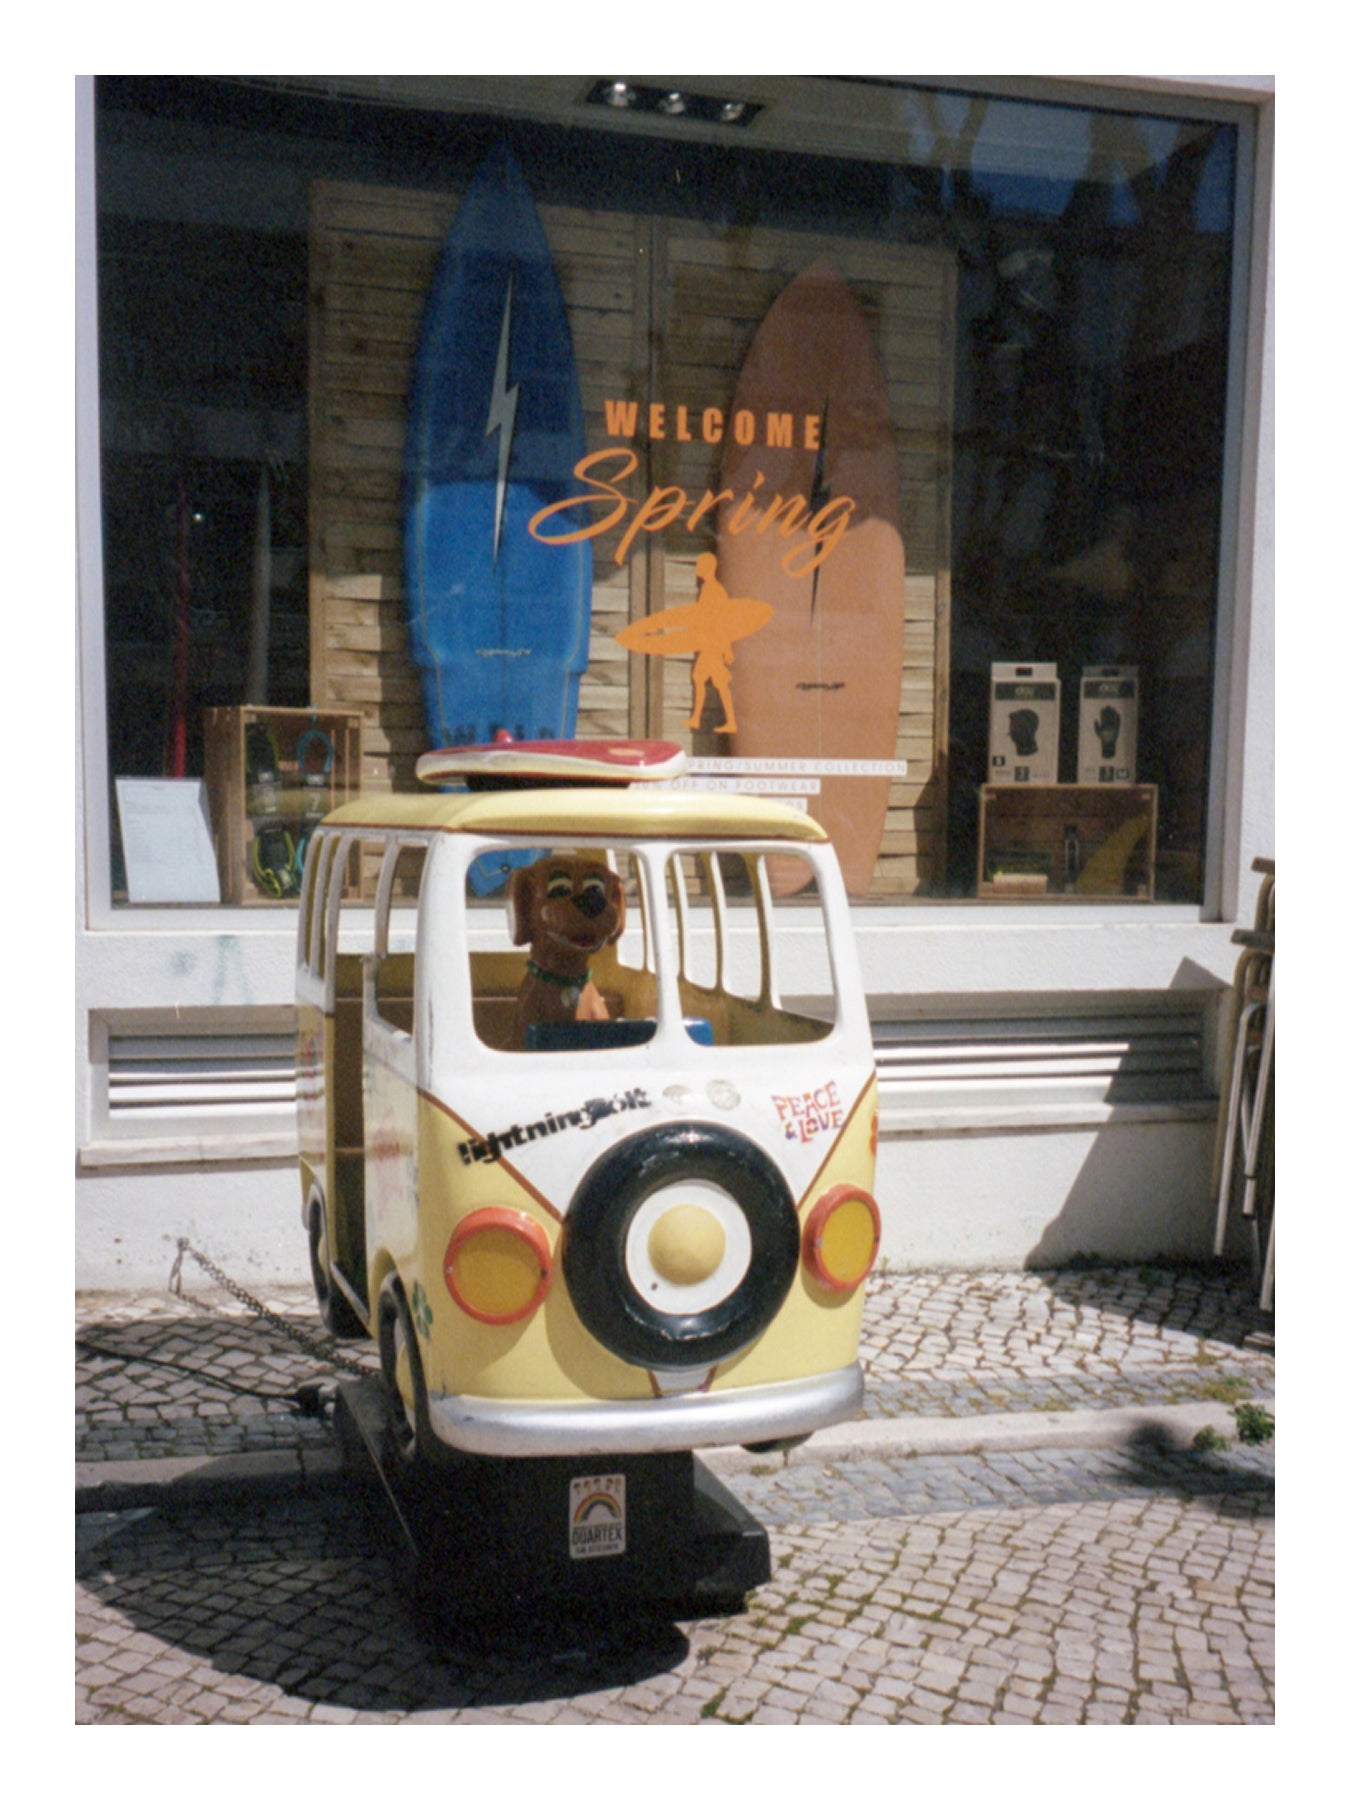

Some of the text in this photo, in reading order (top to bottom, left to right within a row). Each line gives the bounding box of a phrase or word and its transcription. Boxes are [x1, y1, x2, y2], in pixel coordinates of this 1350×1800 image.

[605, 400, 820, 450] WELCOME
[528, 447, 856, 577] Spring
[687, 758, 905, 774] PRING/SUMMER COLLECTION
[671, 780, 697, 791] OFF
[706, 780, 727, 791] ON
[735, 780, 818, 791] FOOTWEAR
[771, 1080, 841, 1121] PEACE
[799, 1109, 845, 1144] LOVE
